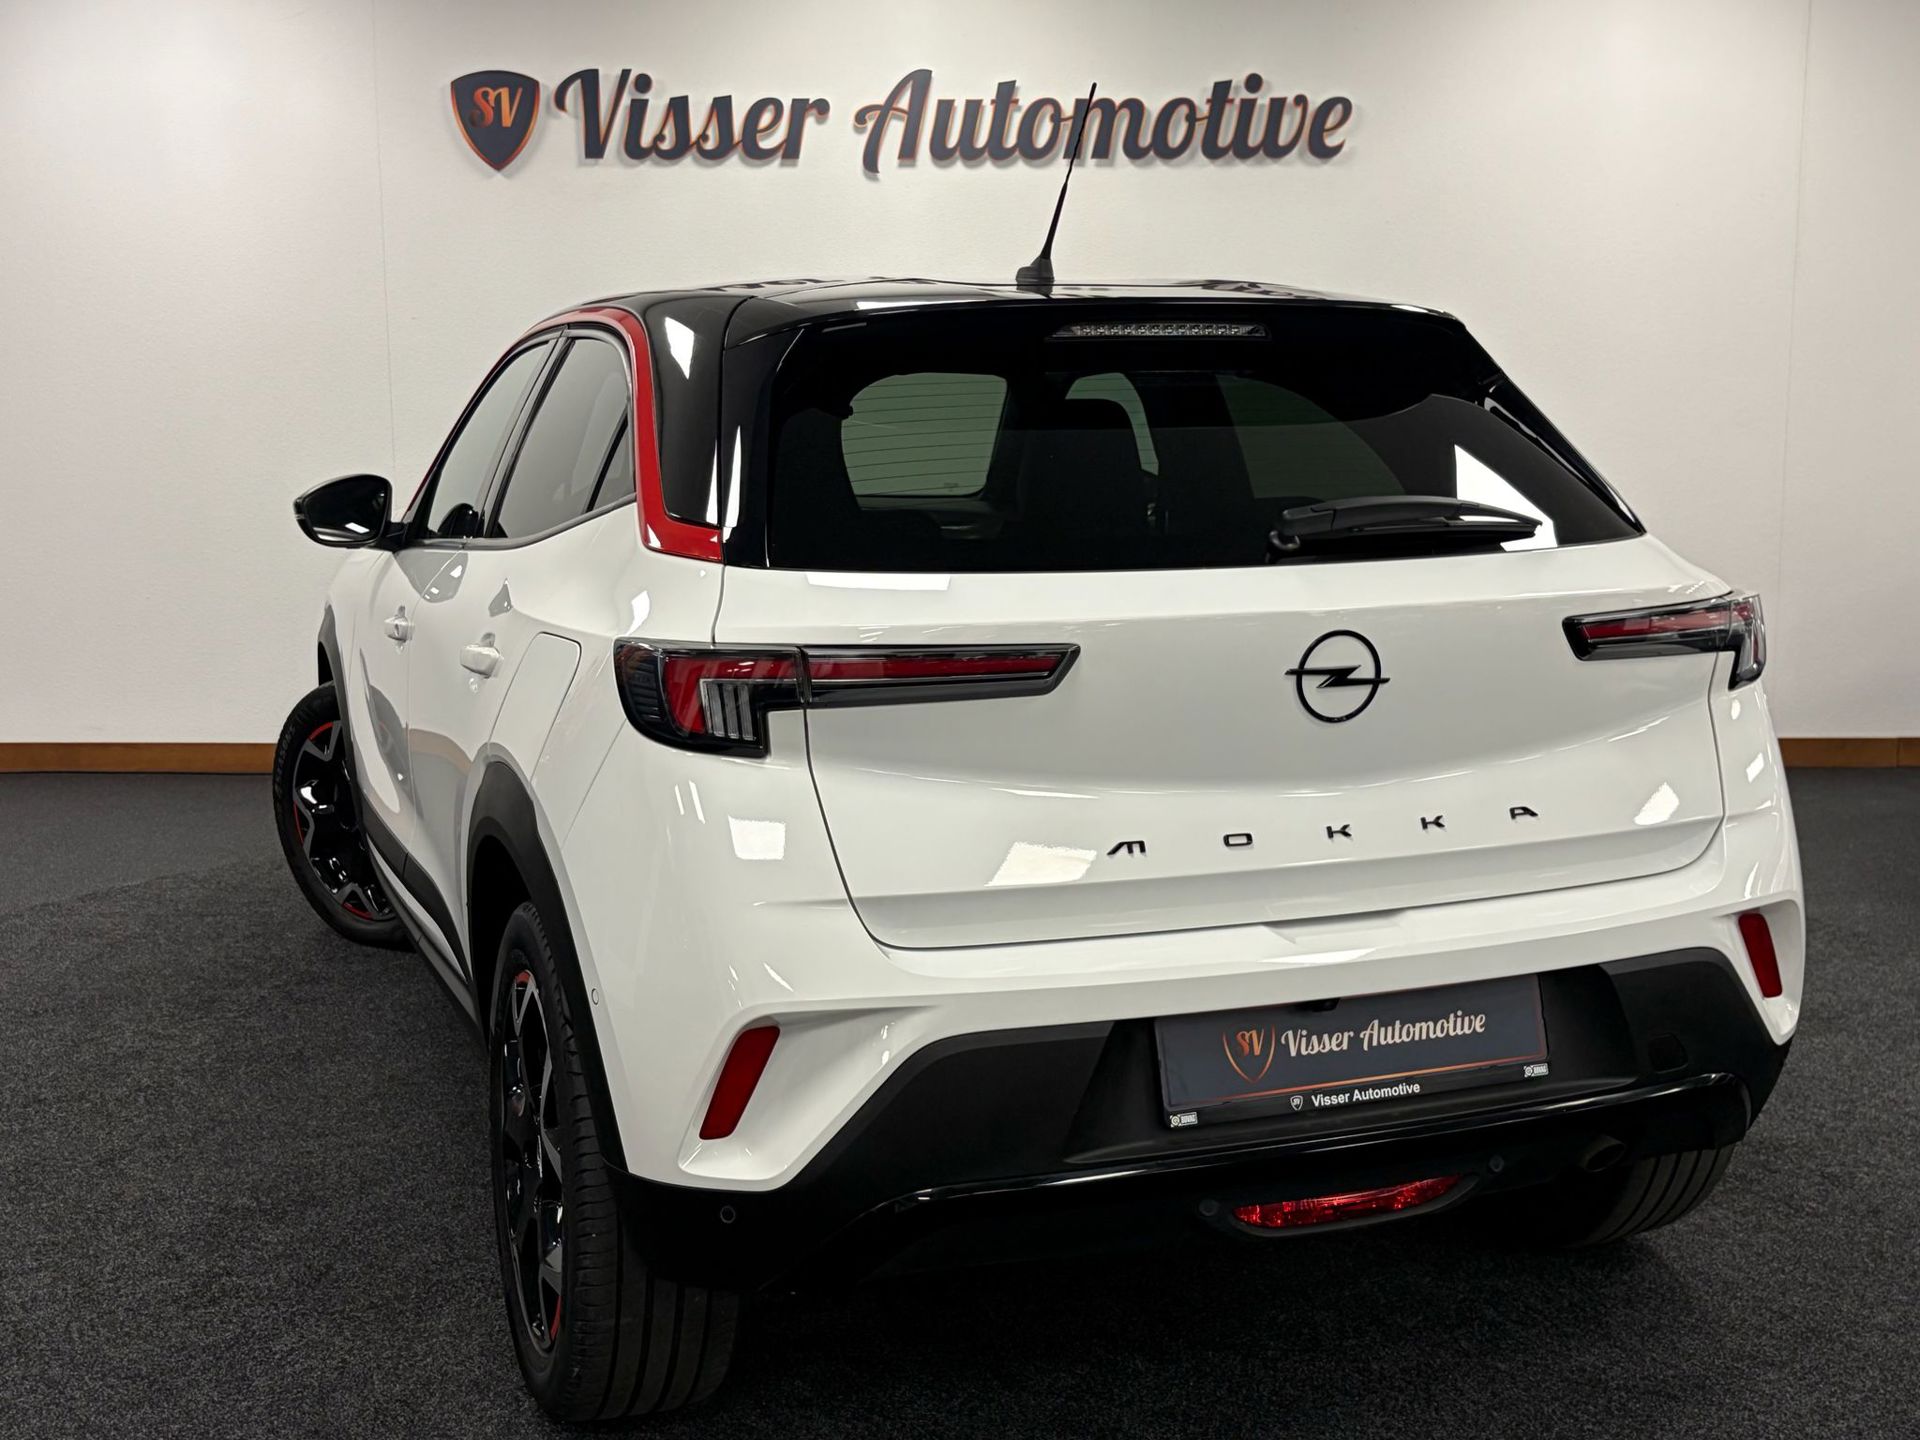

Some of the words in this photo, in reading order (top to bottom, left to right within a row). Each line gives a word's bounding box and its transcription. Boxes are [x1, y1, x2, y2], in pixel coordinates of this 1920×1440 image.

[554, 68, 830, 161] Visser
[854, 68, 1353, 174] Automotive
[1107, 806, 1538, 856] MOKKA
[1281, 1029, 1354, 1057] Visser
[1360, 1010, 1486, 1051] Automotive
[1311, 1093, 1350, 1107] Visser
[1353, 1082, 1420, 1101] Automotive
